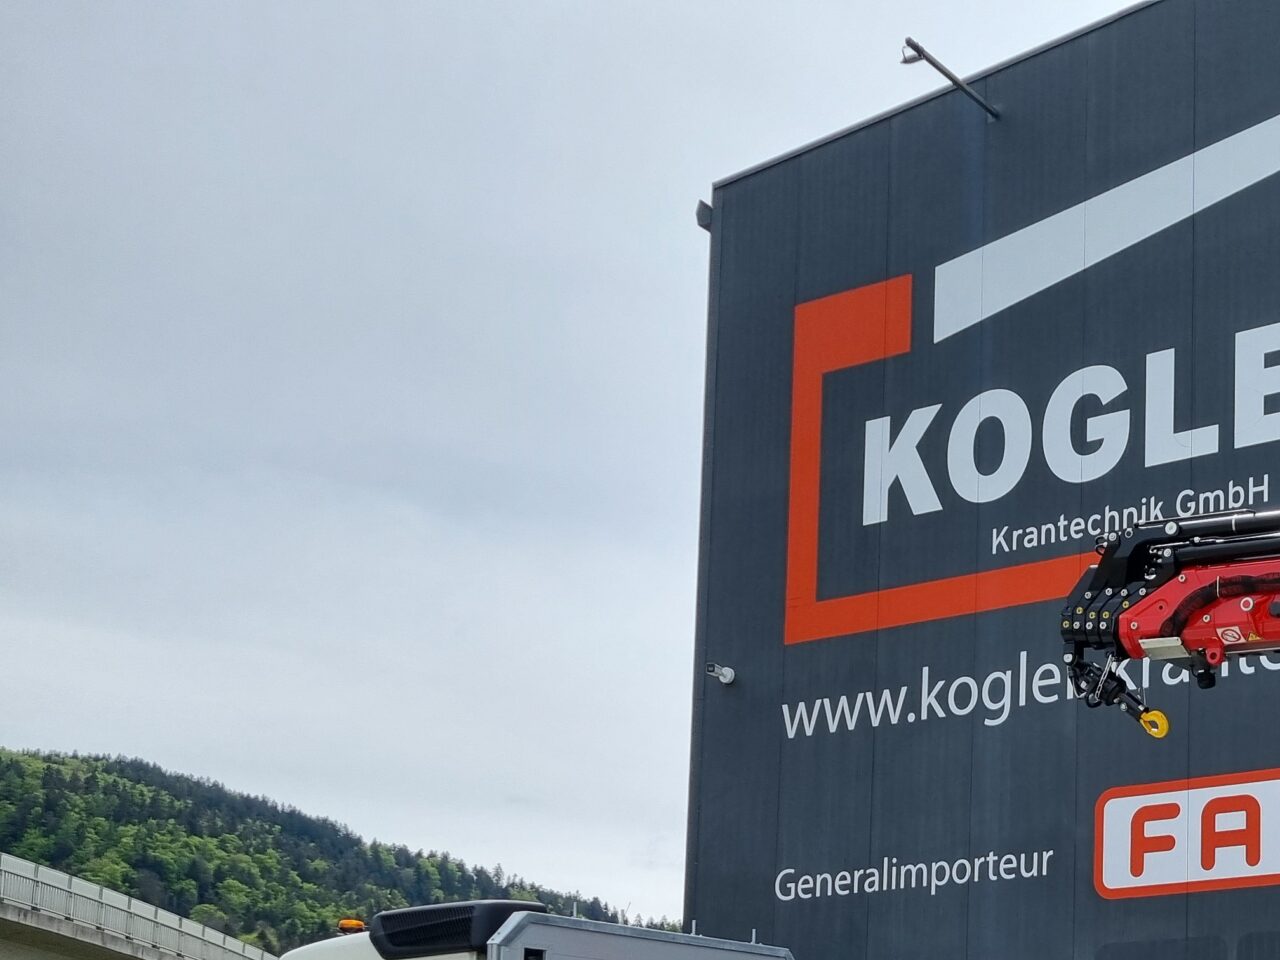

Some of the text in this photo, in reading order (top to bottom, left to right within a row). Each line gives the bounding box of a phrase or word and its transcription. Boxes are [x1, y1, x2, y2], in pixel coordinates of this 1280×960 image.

[992, 473, 1269, 555] Krantechnik GmbH
[774, 848, 1054, 902] Generalimporteur
